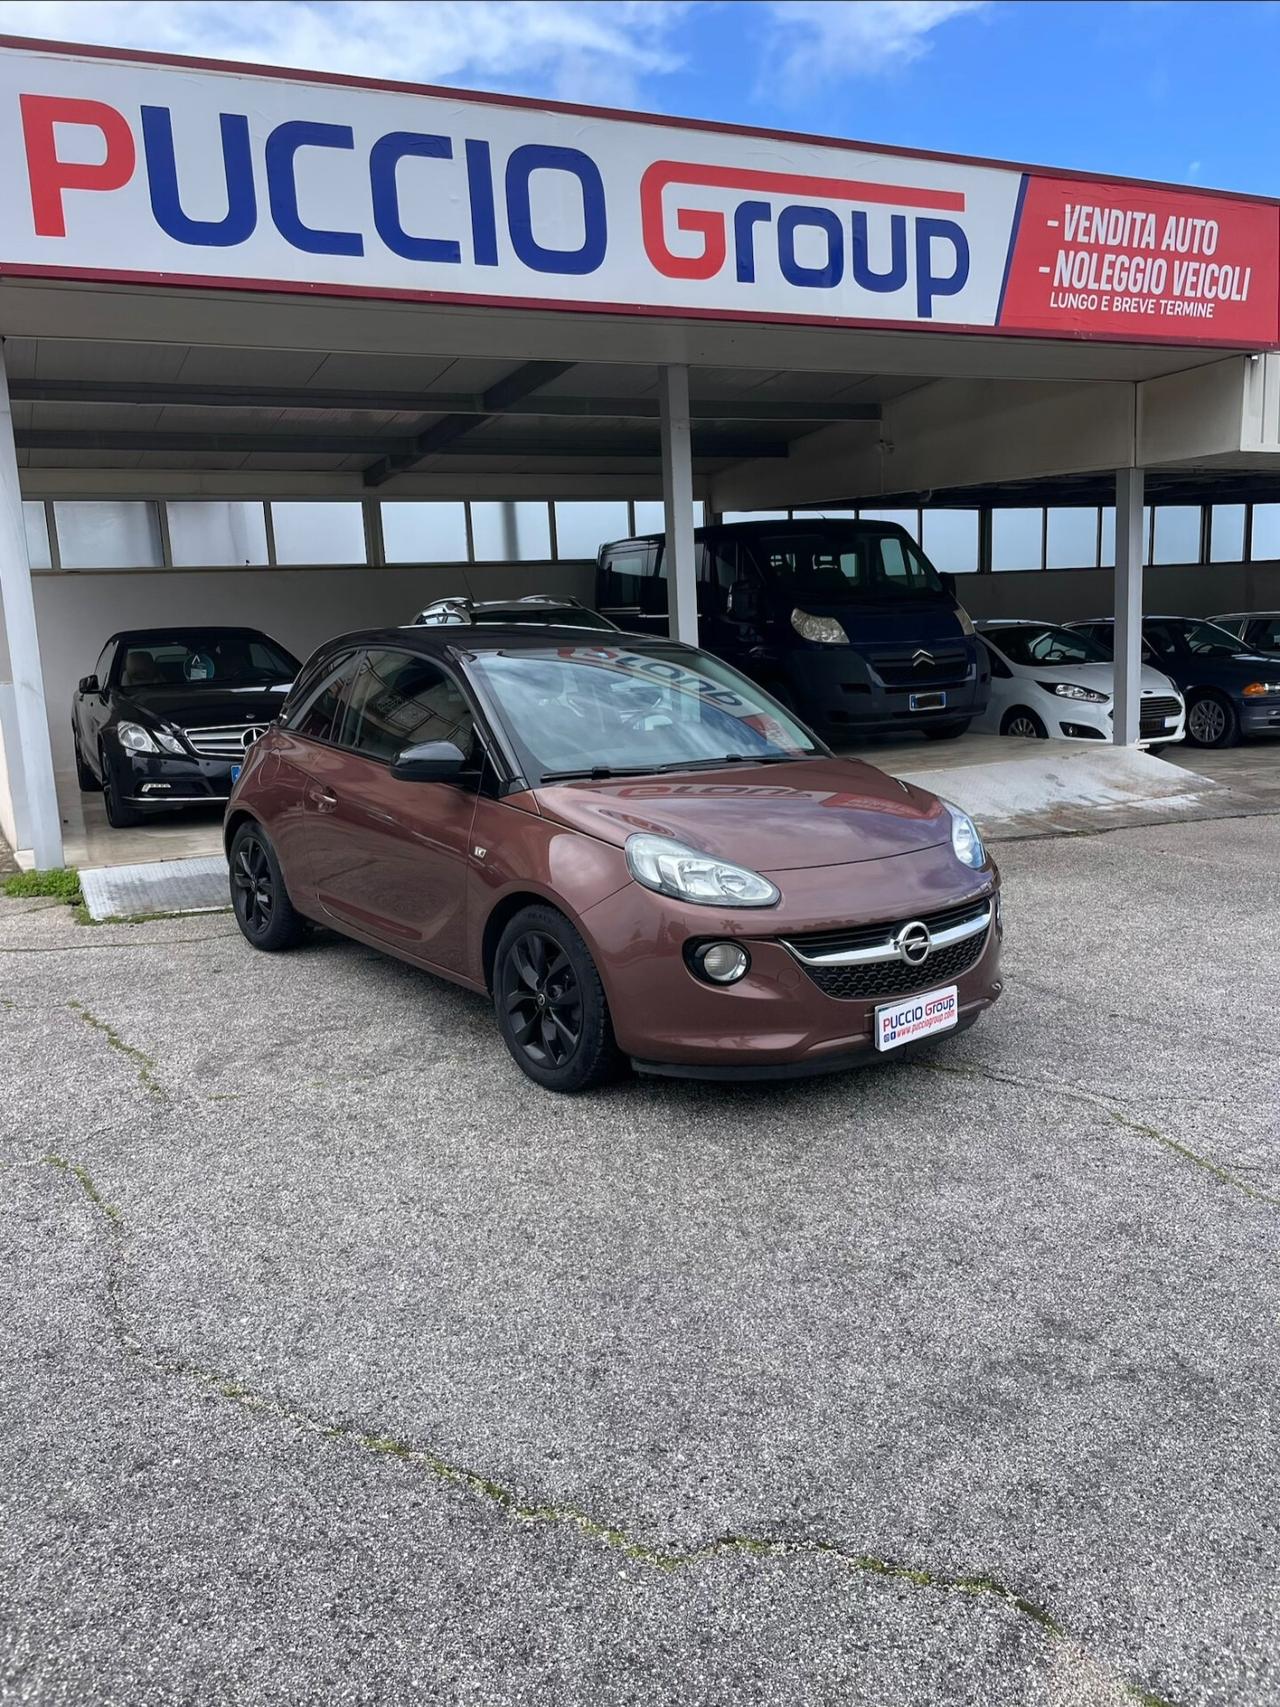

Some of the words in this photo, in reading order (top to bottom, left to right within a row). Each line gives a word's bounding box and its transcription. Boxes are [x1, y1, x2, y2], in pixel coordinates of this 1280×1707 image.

[20, 94, 608, 275] PUCCIO
[1161, 216, 1219, 256] AUTO
[1173, 260, 1251, 301] VEICOLI
[1050, 292, 1097, 310] LUNGO
[1101, 296, 1110, 312] E
[1112, 297, 1156, 314] BREVE
[1160, 300, 1215, 318] TERMINE
[883, 1006, 923, 1032] PUCCIO
